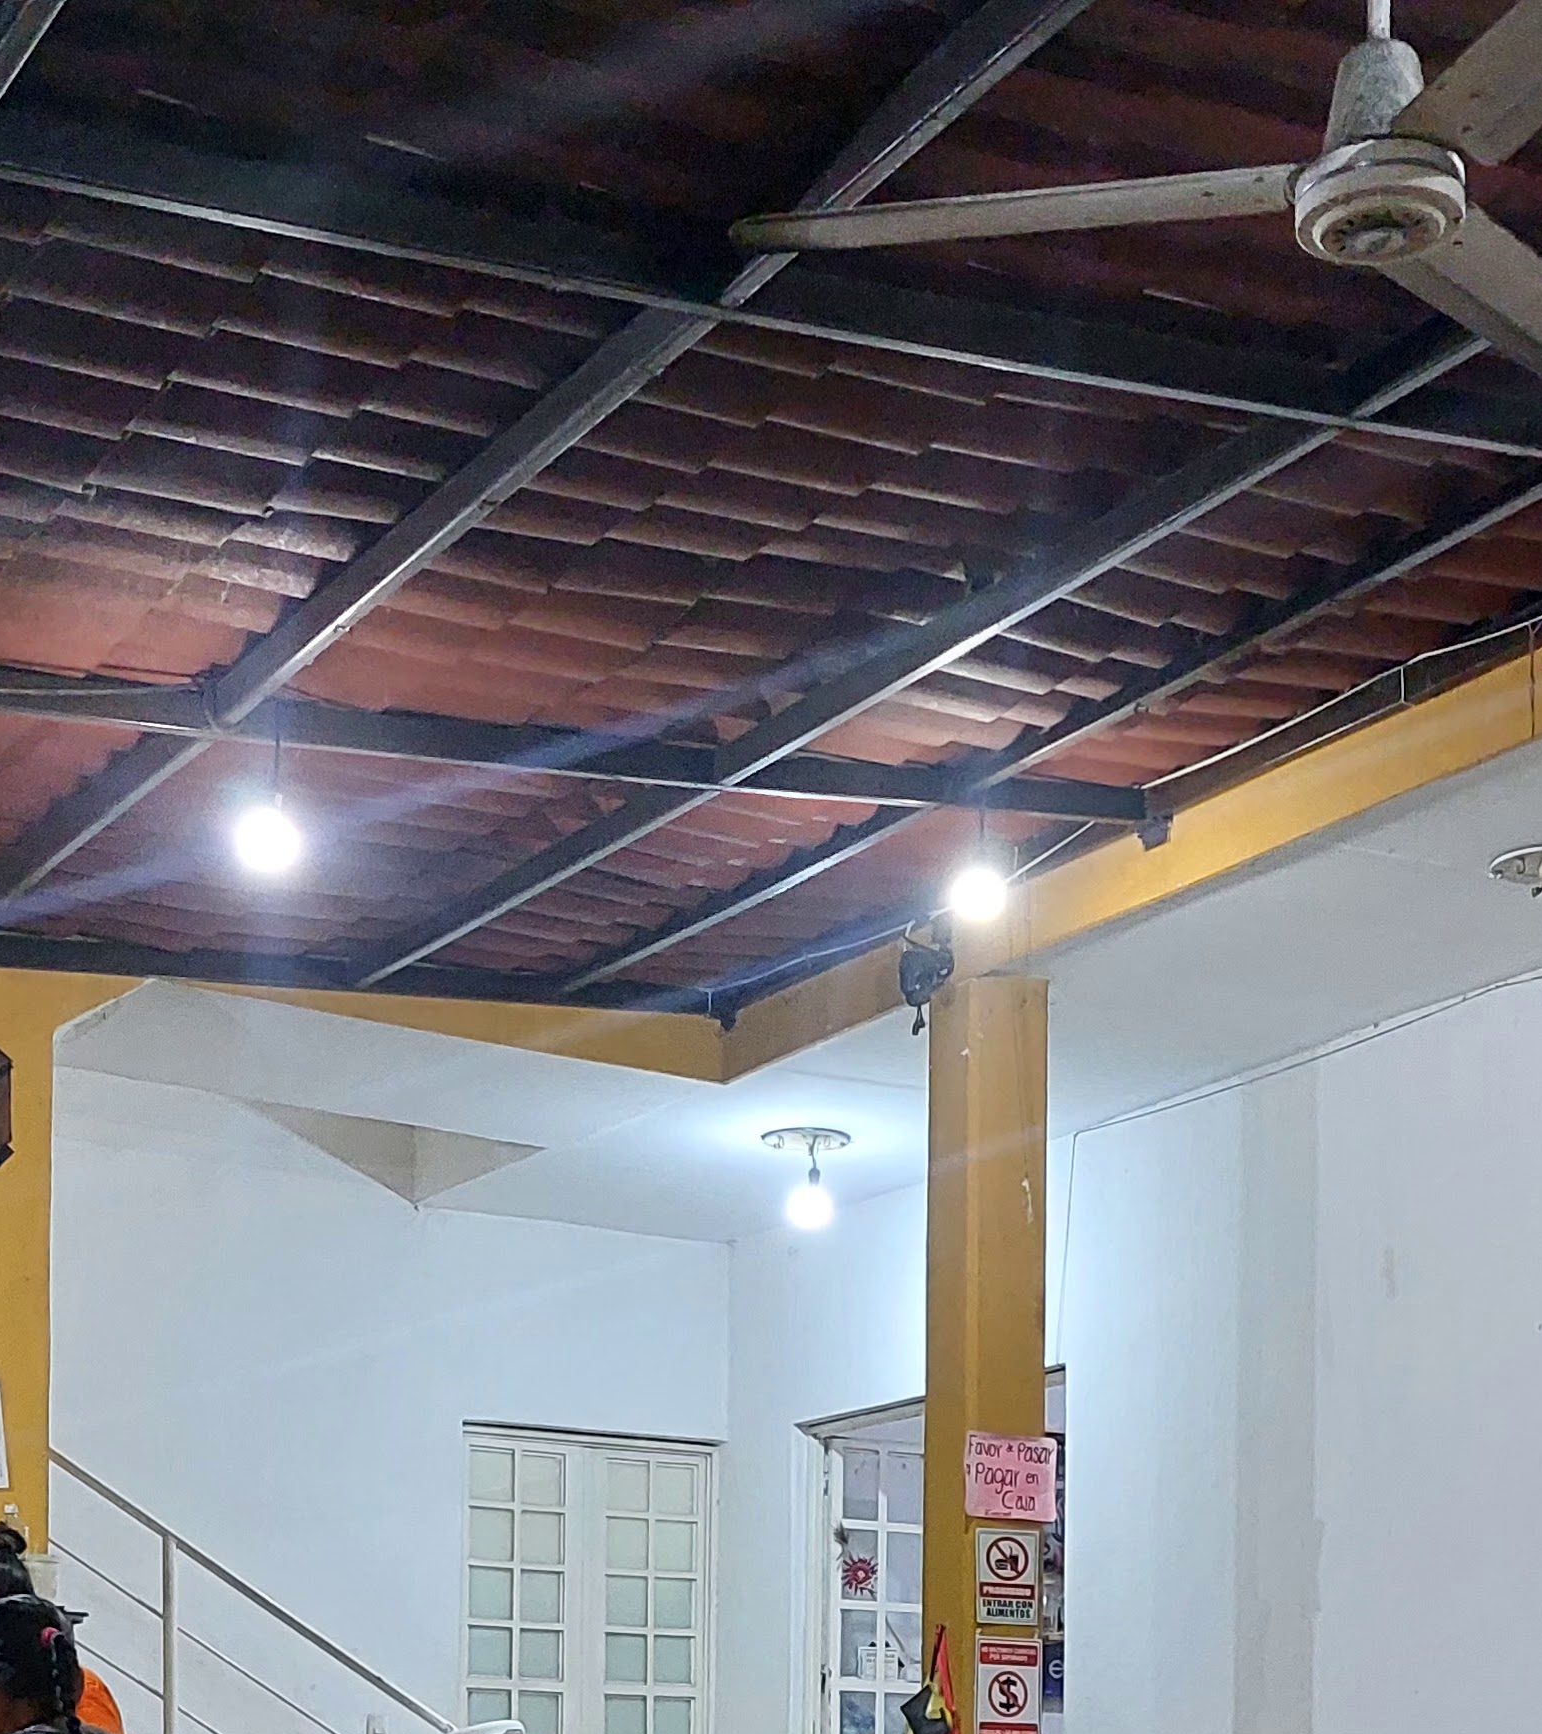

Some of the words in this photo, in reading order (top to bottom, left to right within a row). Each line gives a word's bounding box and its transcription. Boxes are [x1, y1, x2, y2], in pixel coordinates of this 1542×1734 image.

[968, 1434, 1002, 1458] Favor
[1017, 1442, 1054, 1464] Pasar
[975, 1462, 1020, 1494] Pagar
[1025, 1472, 1039, 1486] en
[982, 1598, 1014, 1609] ENTRAR
[1015, 1600, 1033, 1610] CON
[986, 1607, 1031, 1619] ALIMENTOS
